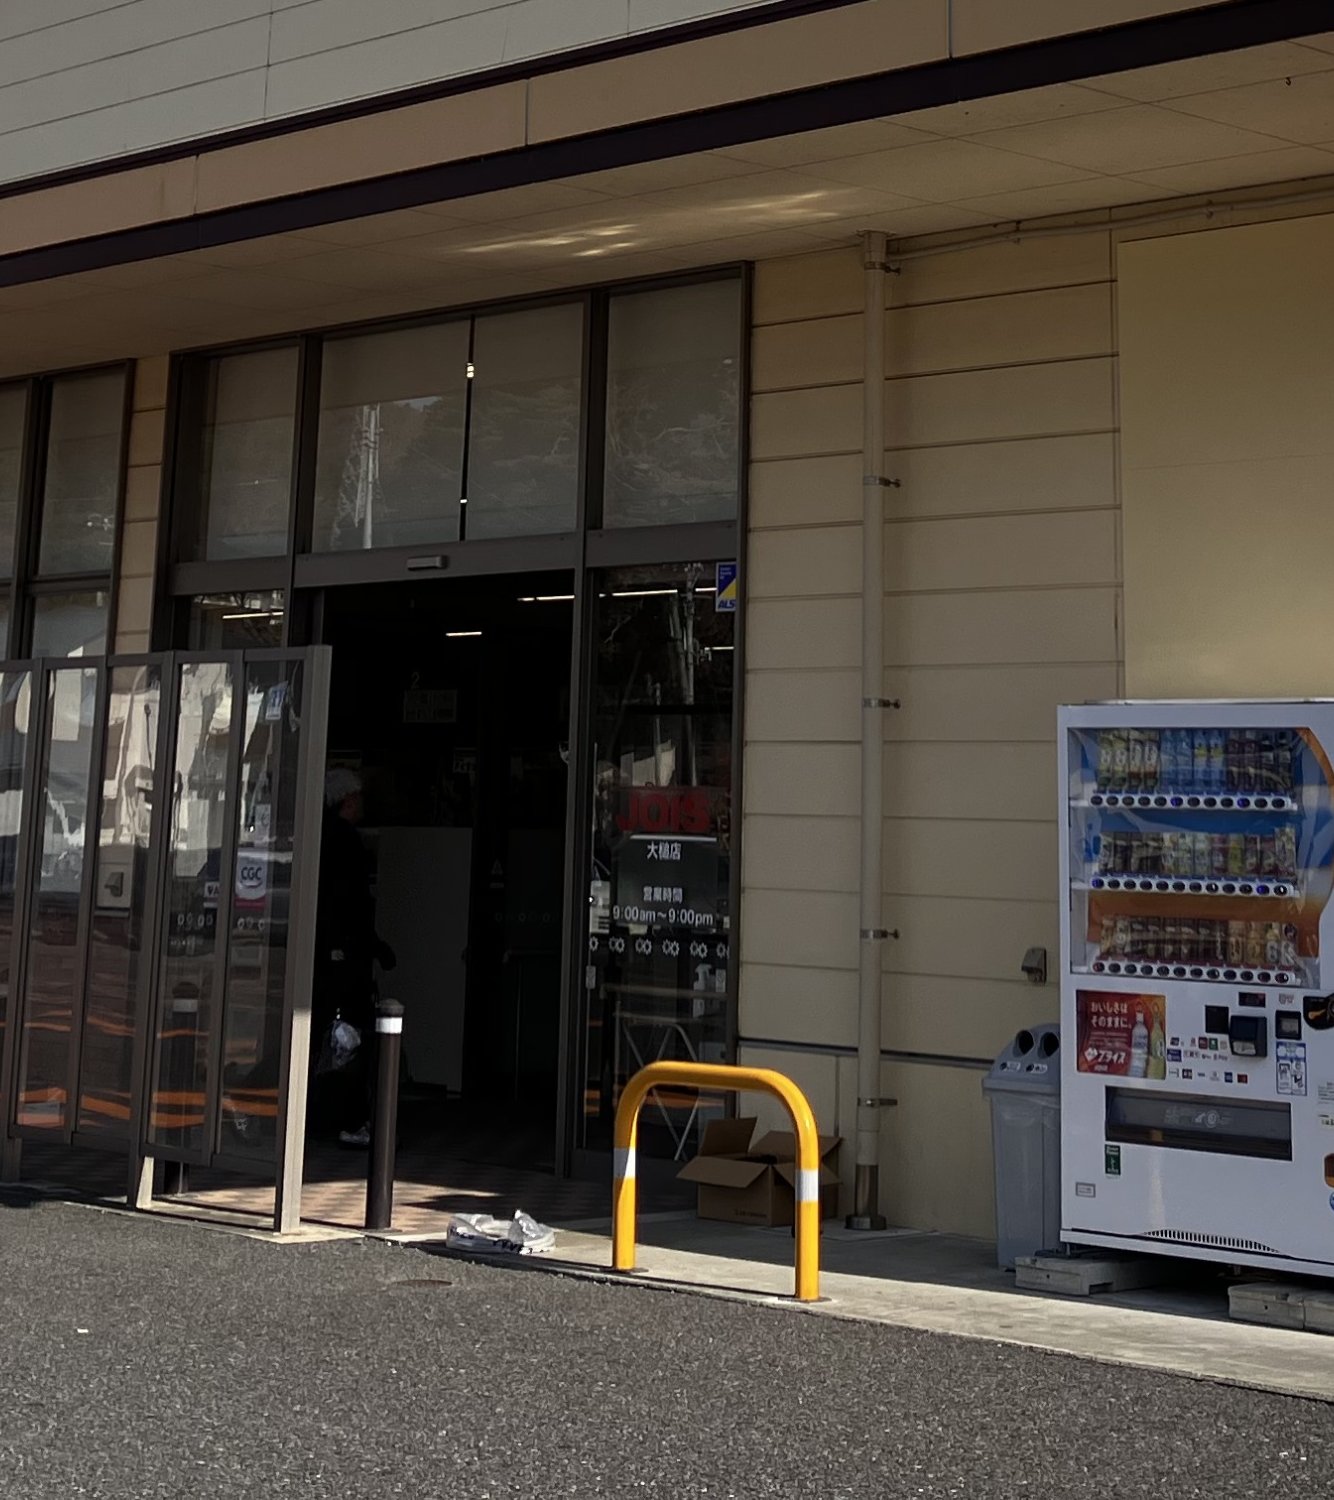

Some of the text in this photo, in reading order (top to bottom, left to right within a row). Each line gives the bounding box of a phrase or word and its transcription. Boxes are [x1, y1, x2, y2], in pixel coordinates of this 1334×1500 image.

[615, 792, 711, 833] JOIS
[241, 866, 263, 881] CGC
[643, 886, 684, 903] 営業時間
